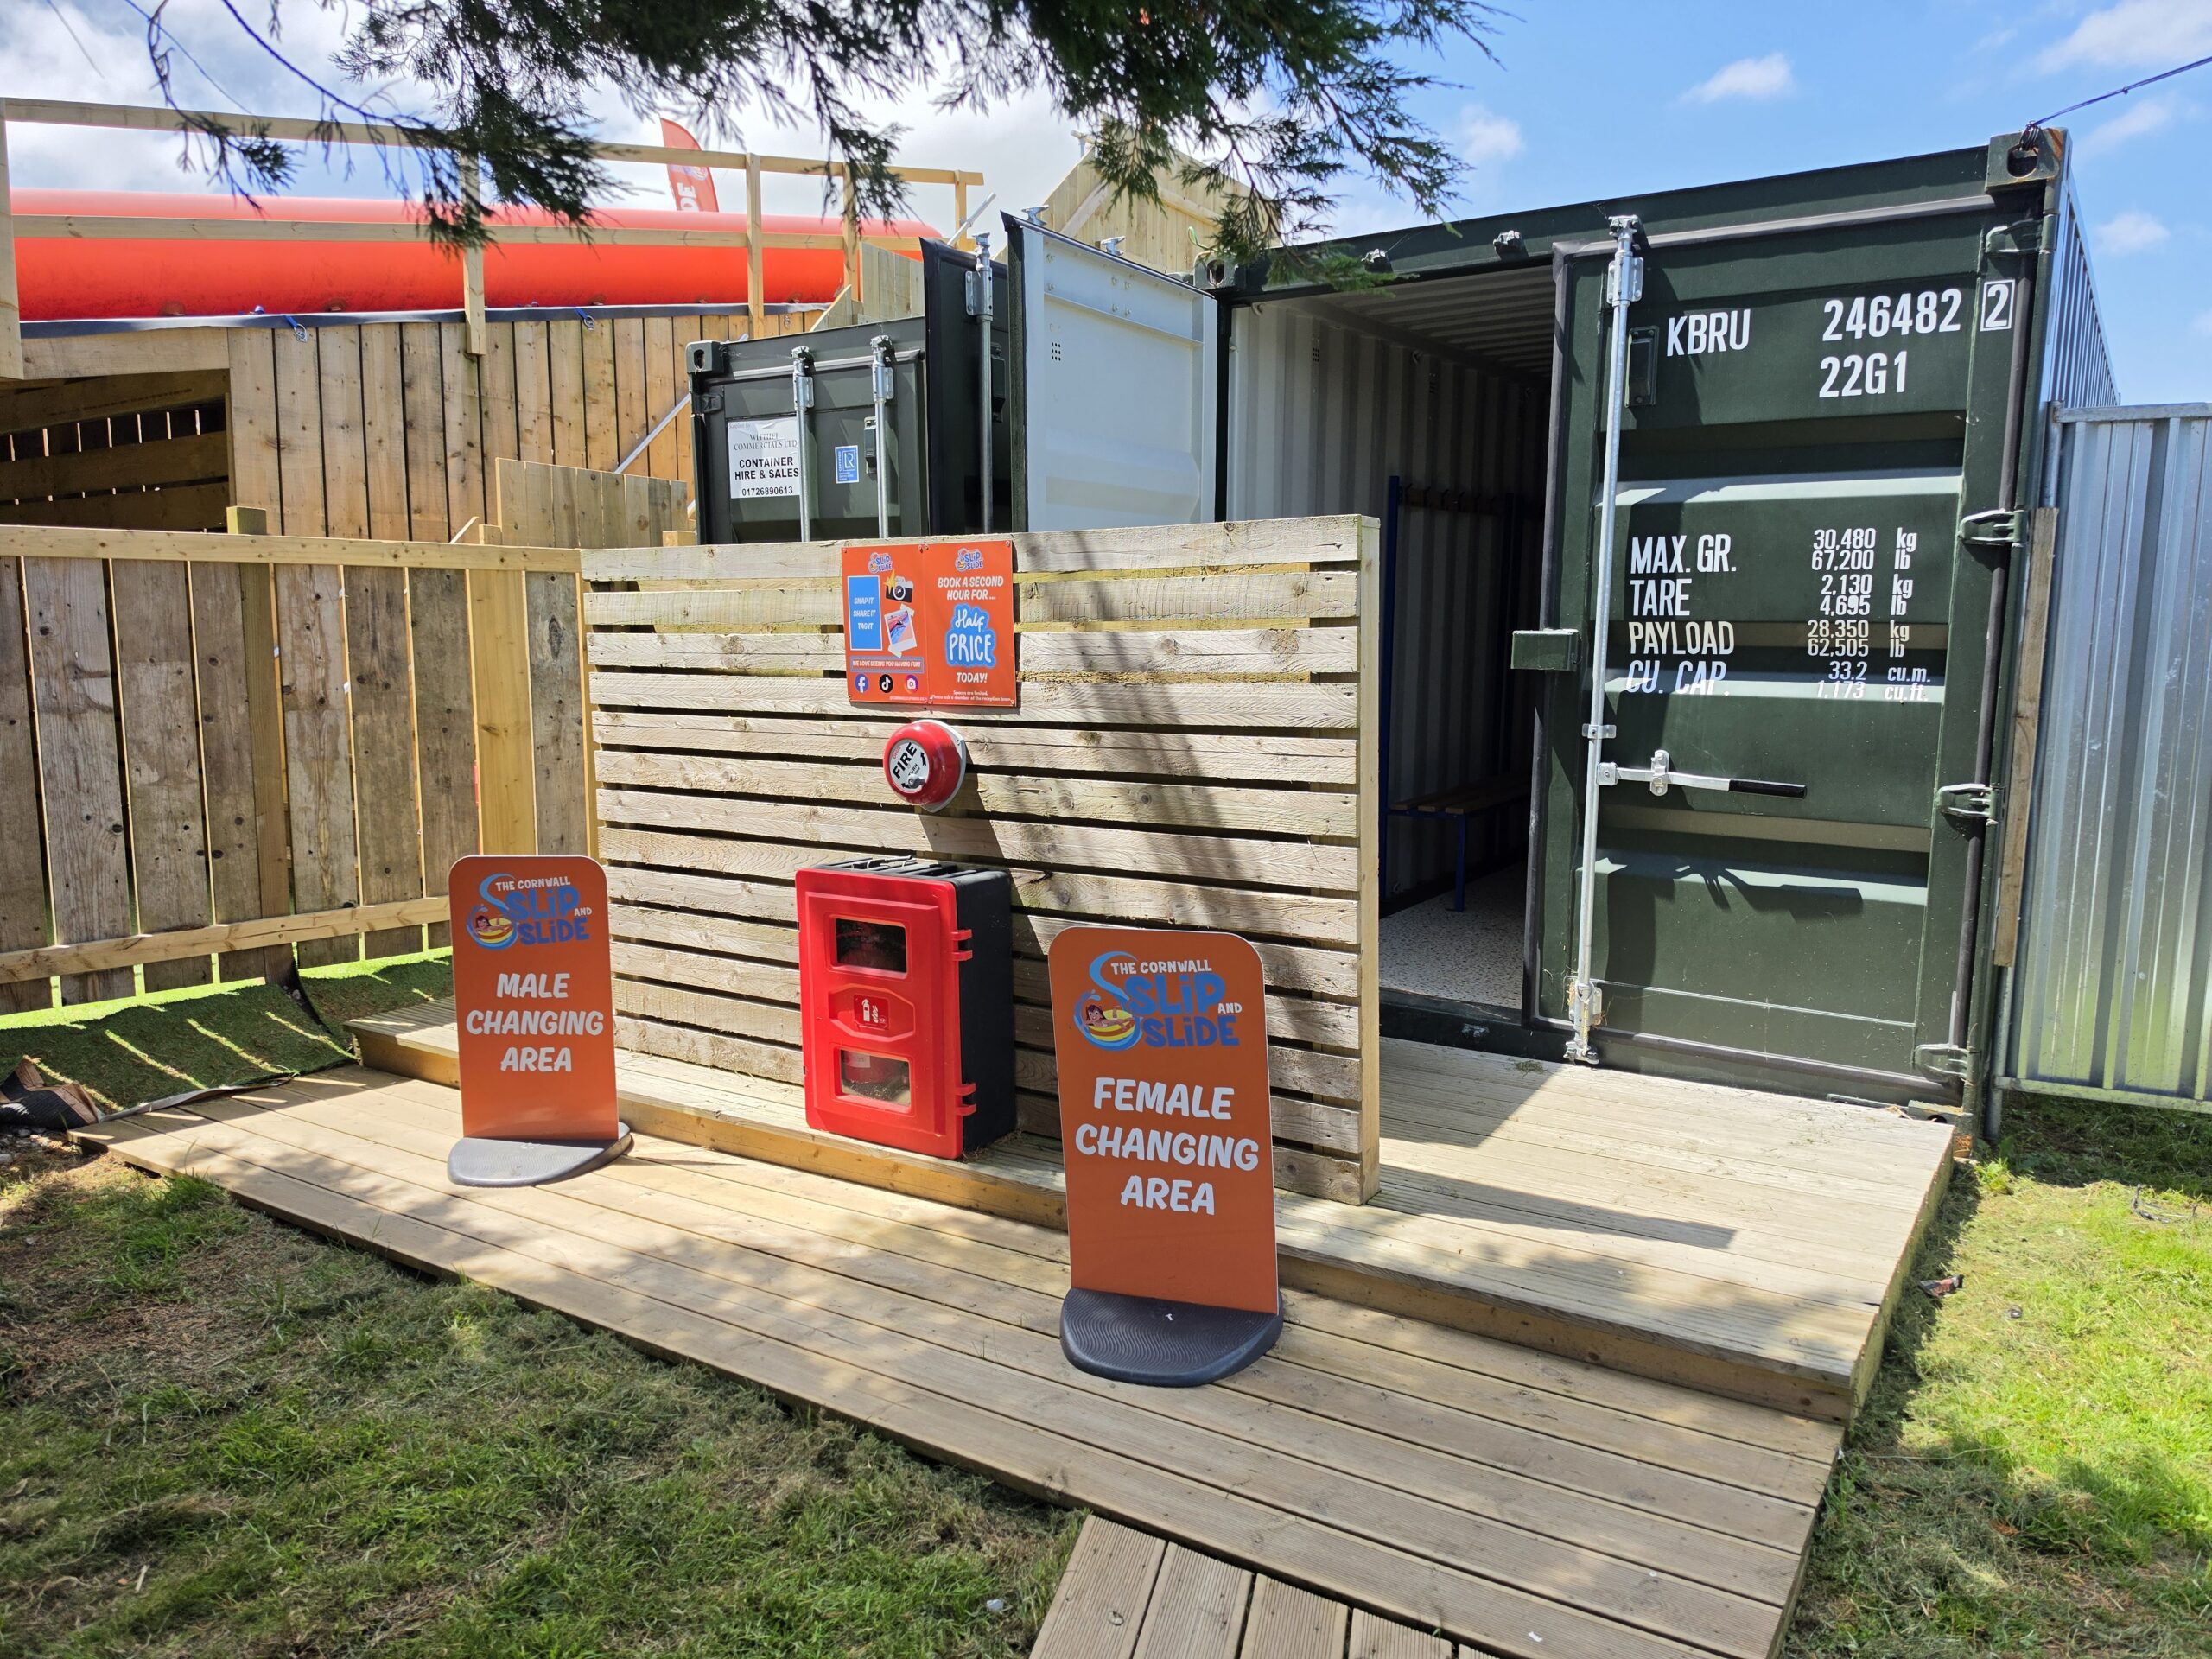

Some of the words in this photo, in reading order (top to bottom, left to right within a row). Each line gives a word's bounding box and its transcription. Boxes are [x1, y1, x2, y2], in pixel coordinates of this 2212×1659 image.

[1666, 308, 1751, 357] KBRU
[1822, 288, 1962, 342] 246482
[1985, 283, 2010, 328] 2
[1819, 351, 1907, 398] 22G1
[734, 440, 783, 451] COMMERCIALS
[784, 439, 798, 448] LTD
[734, 470, 756, 480] HIRE
[759, 469, 766, 479] &
[768, 467, 799, 479] SALES
[739, 456, 794, 468] CONTAINER
[741, 486, 793, 496] 01726890613
[1813, 527, 1877, 550] 30,480
[1896, 527, 1917, 552] kg
[1811, 549, 1875, 571] 67,200
[1894, 548, 1910, 570] lb
[938, 576, 962, 588] BOOK
[962, 576, 969, 588] A
[969, 575, 1004, 588] SECOND
[1821, 574, 1872, 595] 2,130
[1892, 573, 1913, 599] kg
[854, 596, 868, 605] SNAP
[946, 589, 970, 601] HOUR
[1630, 578, 1692, 616] TARE
[1820, 594, 1871, 617] 4,695
[1891, 594, 1907, 616] lb
[955, 609, 984, 632] Half
[1807, 619, 1869, 639] 28,350
[1889, 620, 1910, 642] kg
[949, 632, 992, 664] PRICE
[1628, 620, 1735, 655] PAYLOAD
[1808, 638, 1869, 658] 62,505
[1889, 639, 1905, 658] lb
[956, 672, 988, 683] TODAY!
[1625, 659, 1663, 694] CU.
[1675, 660, 1730, 696] CAP.
[1828, 660, 1868, 681] 33.2
[892, 741, 917, 780] FIRE
[495, 880, 516, 892] THE
[517, 875, 571, 890] CORNWALL
[574, 906, 593, 917] AND
[1111, 962, 1137, 976] THE
[1140, 959, 1212, 974] CORNWALL
[497, 973, 570, 999] MALE
[1217, 1001, 1243, 1014] AND
[466, 1009, 604, 1036] CHANGING
[500, 1046, 572, 1072] AREA
[1094, 1077, 1235, 1120] FEMALE
[1075, 1123, 1259, 1171] CHANGING
[1120, 1174, 1215, 1216] AREA
